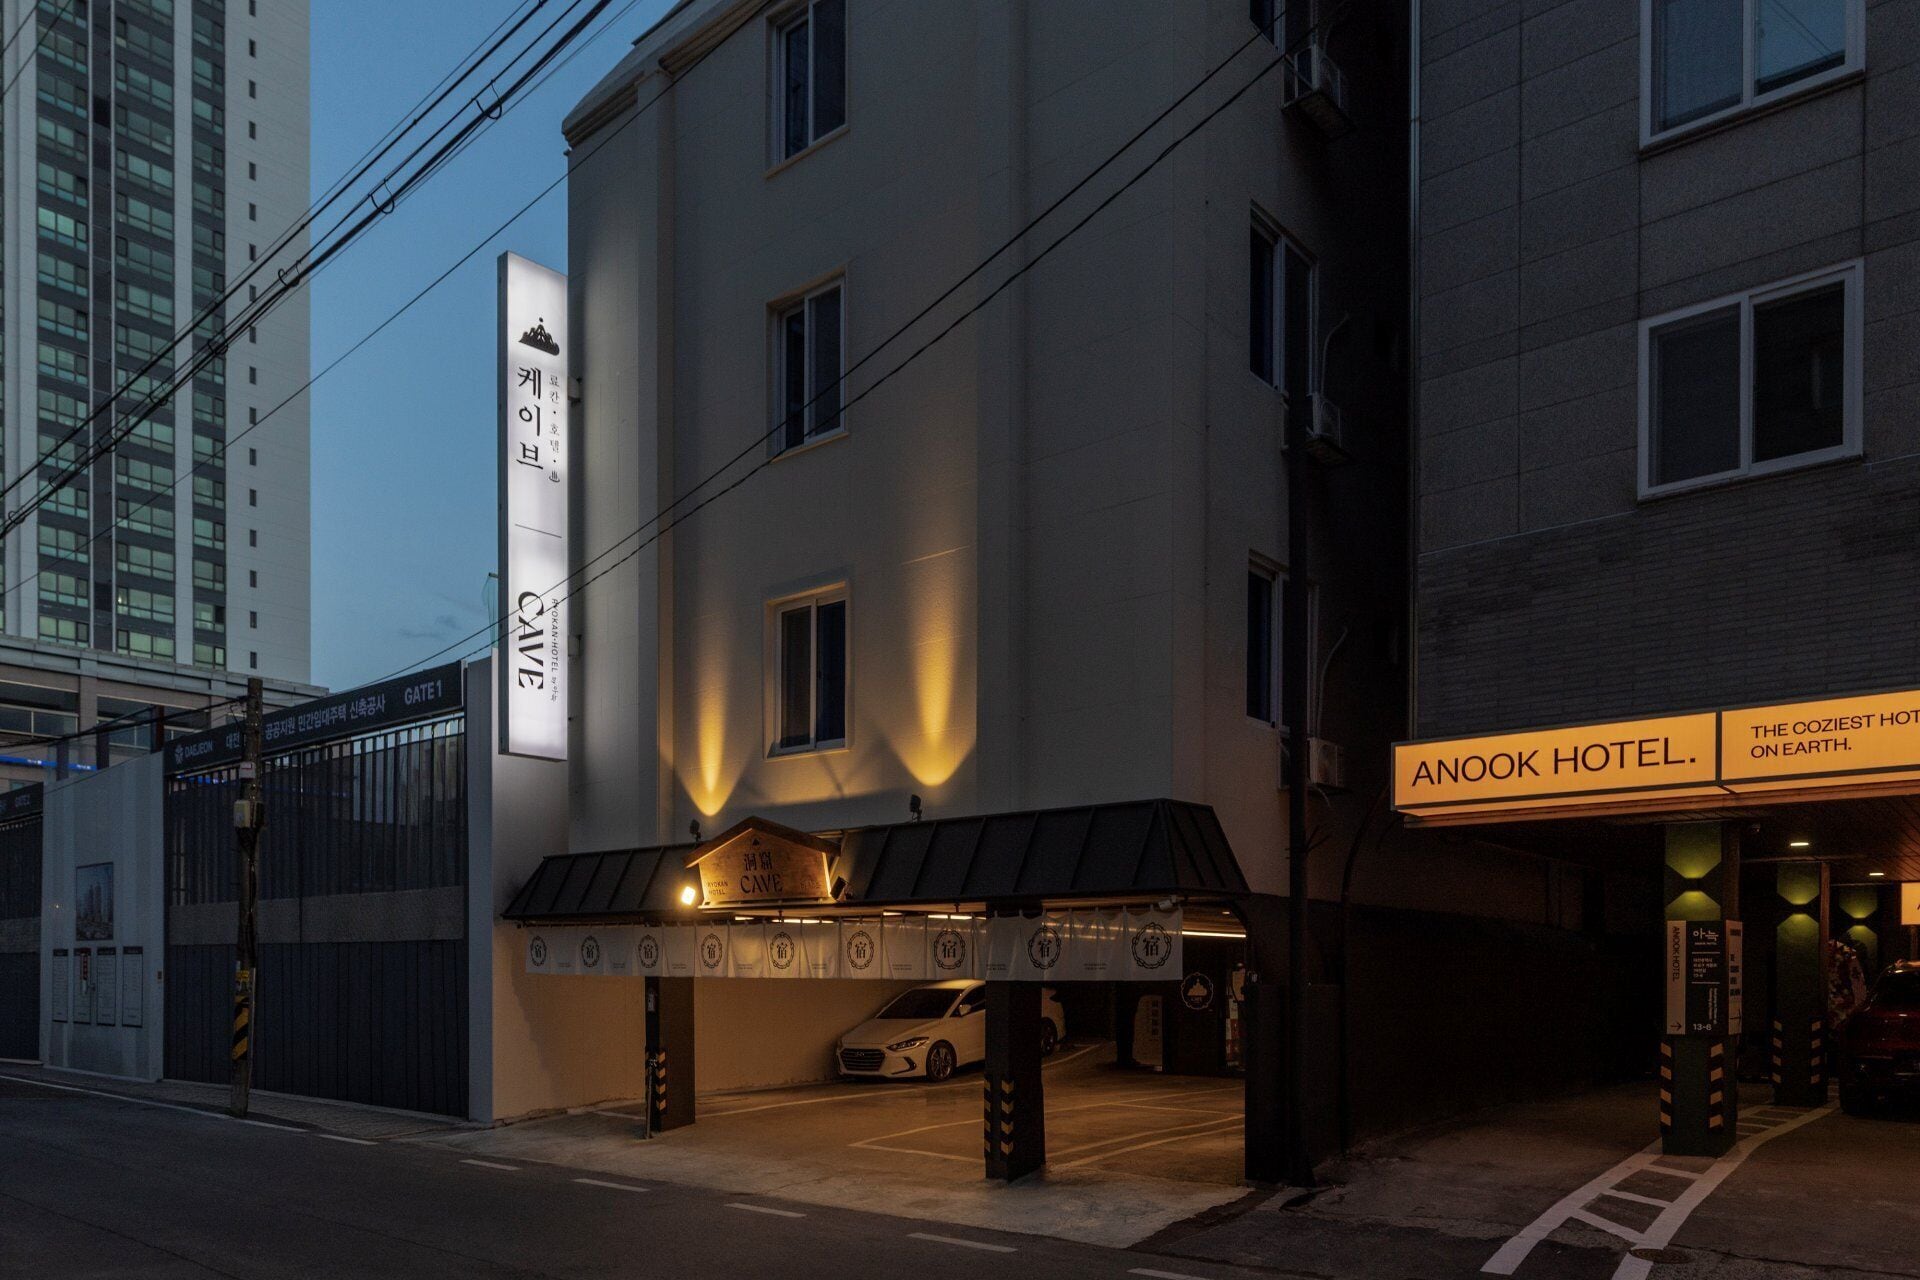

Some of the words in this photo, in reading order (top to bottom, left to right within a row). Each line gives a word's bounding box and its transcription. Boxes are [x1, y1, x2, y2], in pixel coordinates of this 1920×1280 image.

[516, 365, 544, 470] 케이브
[518, 591, 544, 690] CAVE
[265, 716, 296, 740] 공공지원
[298, 703, 347, 732] 민간임대주택
[349, 693, 386, 720] 신축공사
[1751, 723, 1788, 738] THE
[1793, 714, 1875, 735] COZIEST
[1751, 744, 1778, 758] ON
[1783, 738, 1852, 756] EARTH.
[1412, 749, 1540, 787] ANOOK
[1554, 737, 1697, 774] HOTEL.
[740, 874, 783, 894] CAVE
[941, 939, 957, 958] 宿
[1142, 935, 1161, 957] 宿
[1672, 926, 1681, 956] ANOOK
[1672, 956, 1681, 982] HOTEL
